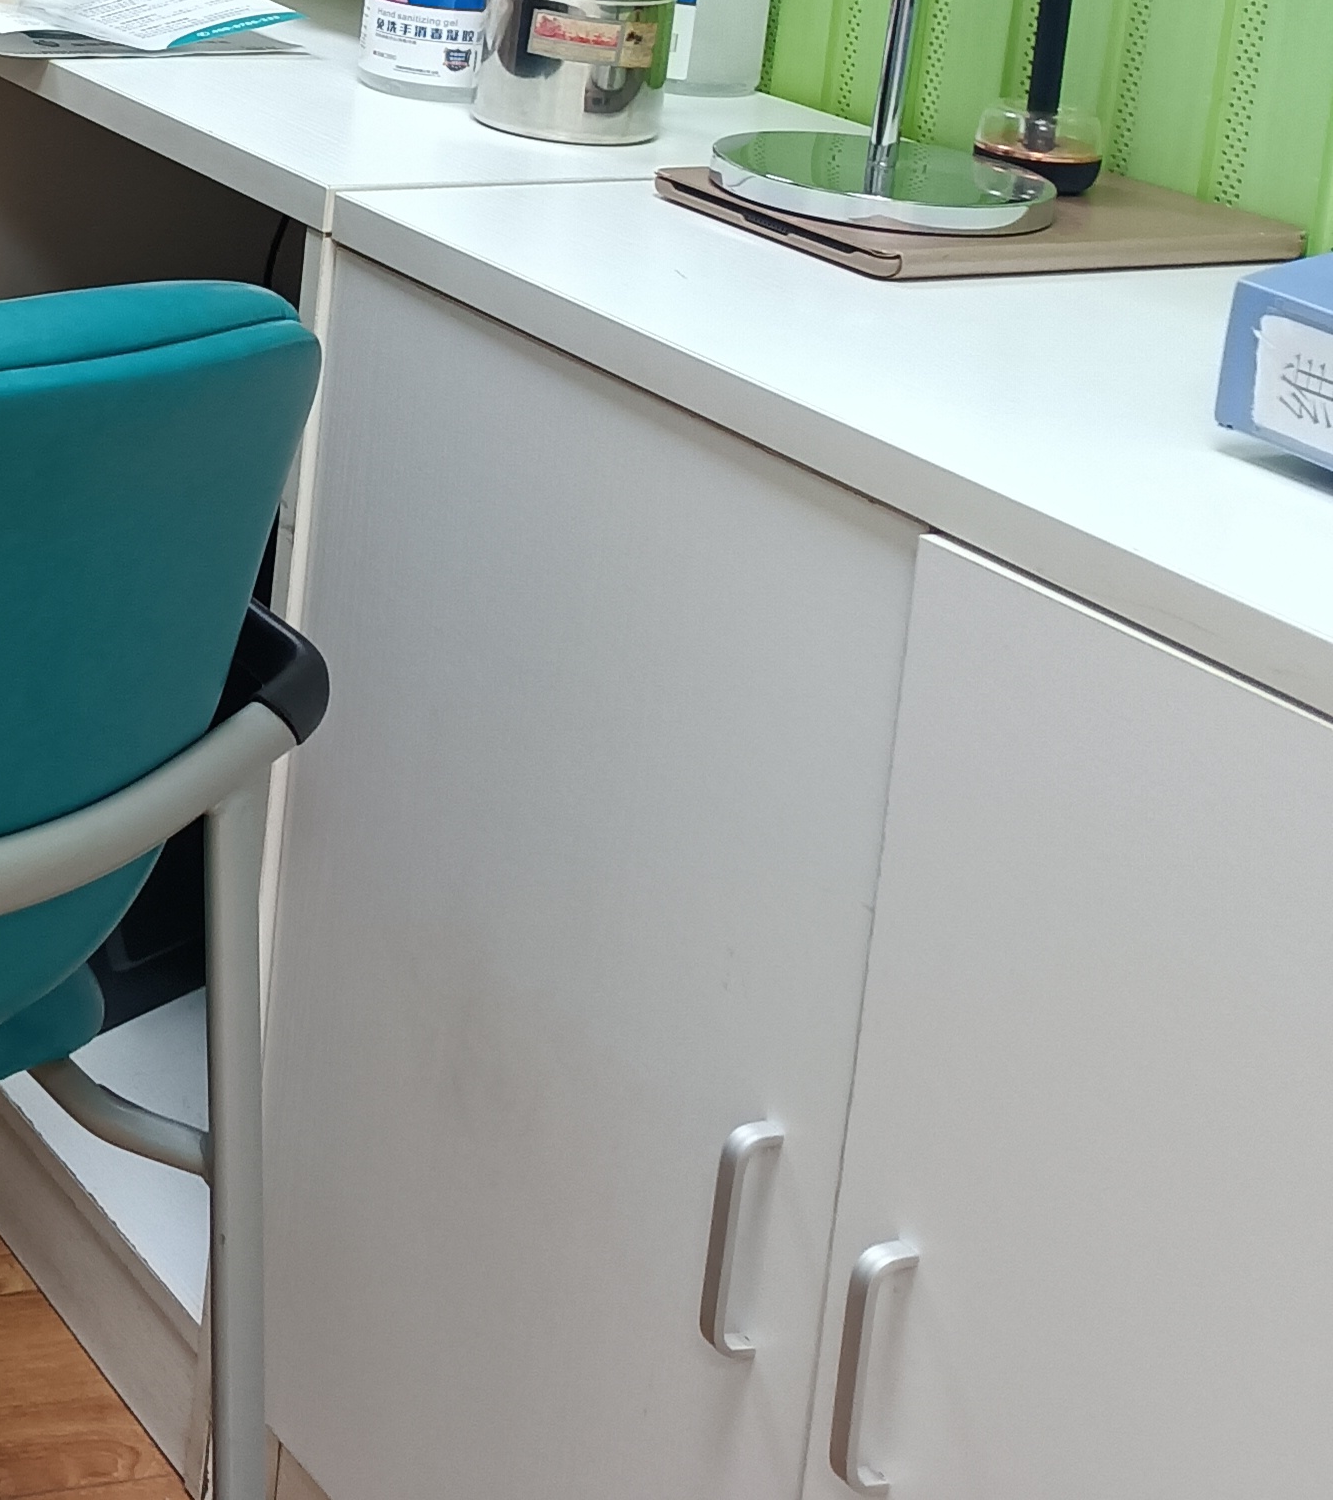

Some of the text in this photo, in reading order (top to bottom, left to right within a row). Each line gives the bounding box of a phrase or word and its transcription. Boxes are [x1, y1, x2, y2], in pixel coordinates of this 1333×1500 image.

[378, 8, 458, 28] Hand sanitizing gel
[376, 18, 474, 42] 免洗手消毒凝胶
